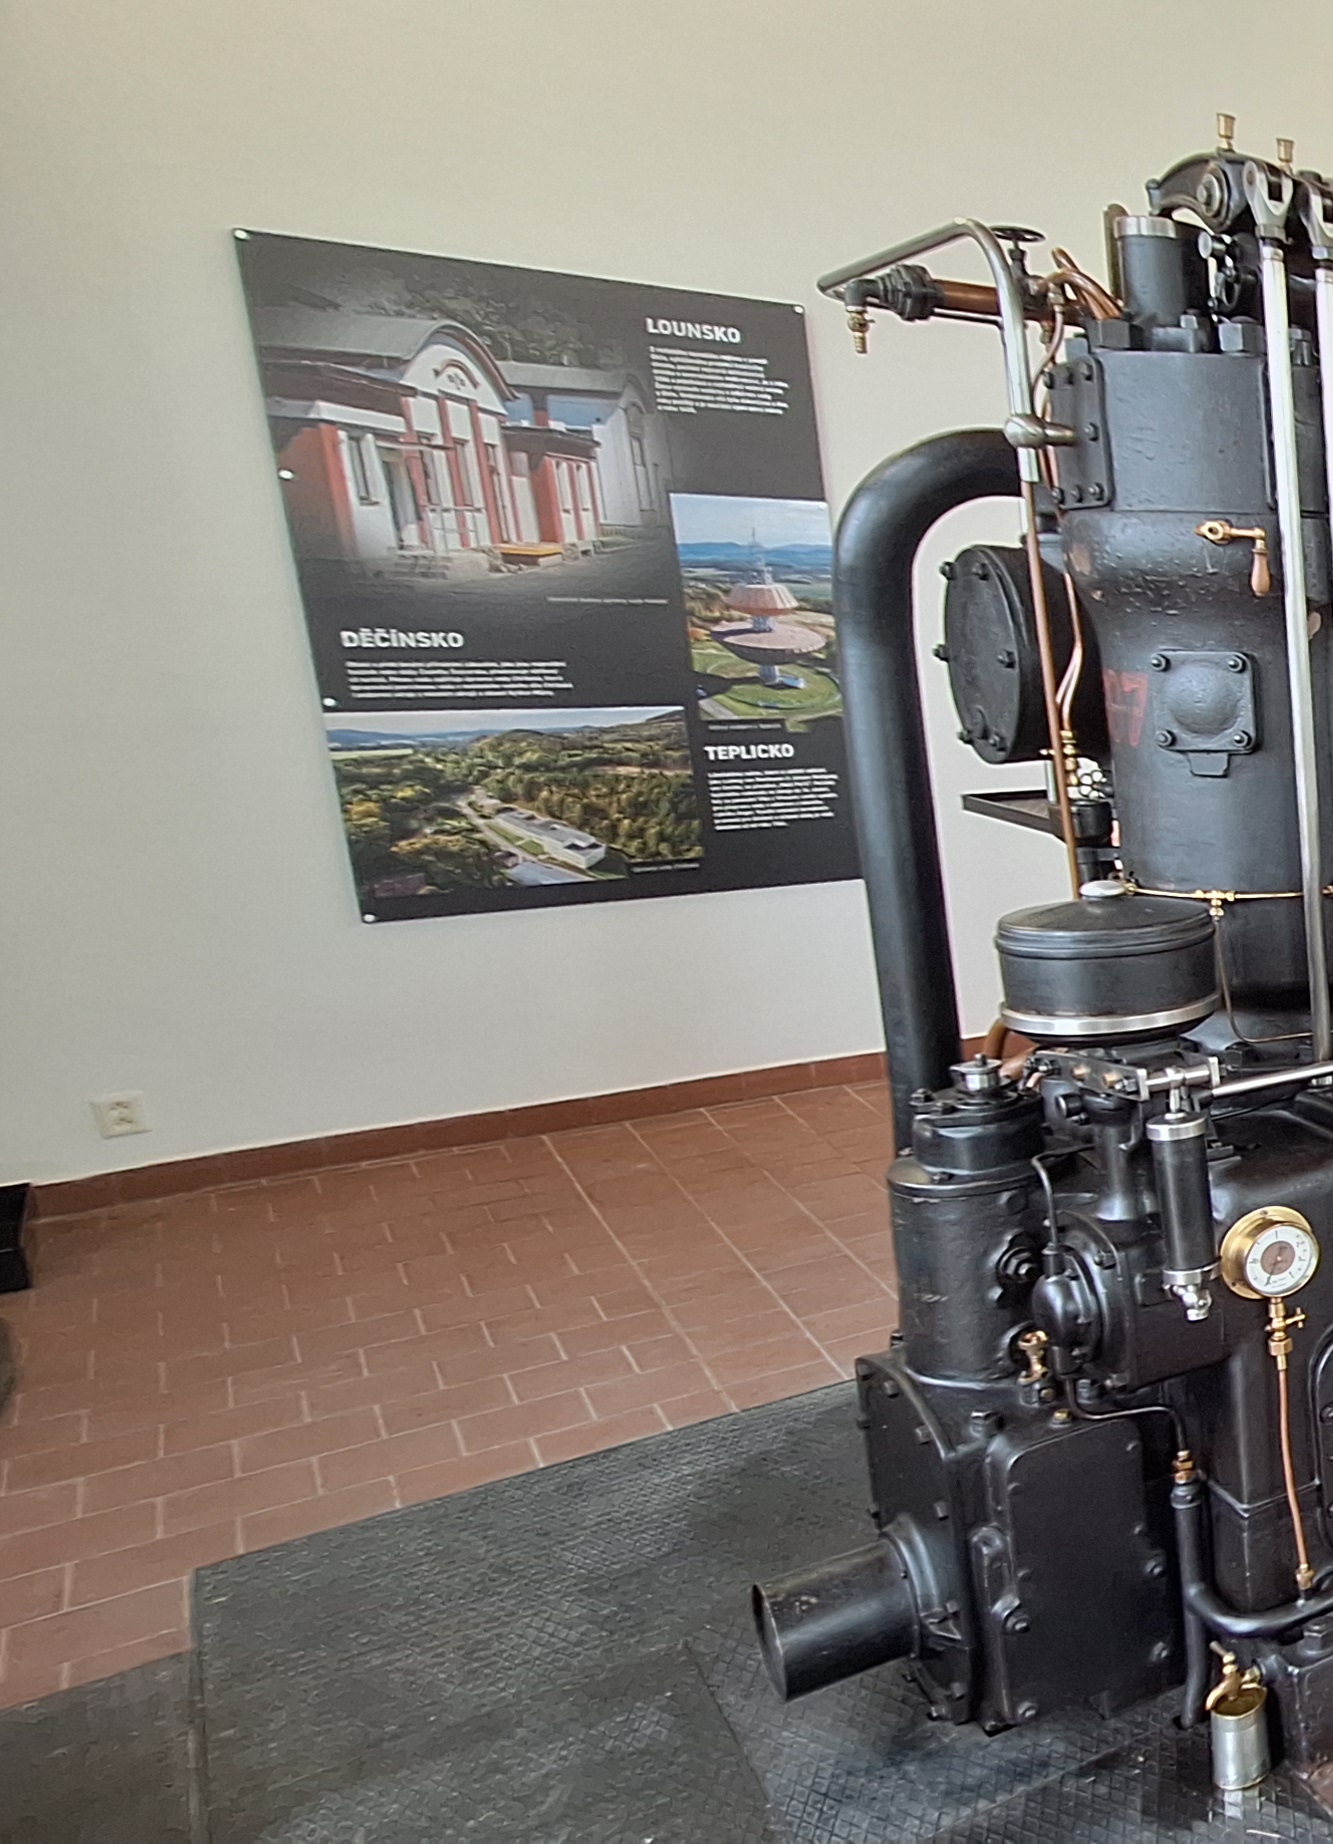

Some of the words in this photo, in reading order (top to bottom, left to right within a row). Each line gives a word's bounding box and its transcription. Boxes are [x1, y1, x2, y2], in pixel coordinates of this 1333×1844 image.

[645, 317, 741, 343] LOUNSKO
[340, 627, 464, 648] DĚČÍNSKO
[703, 743, 795, 760] TEPLICKO
